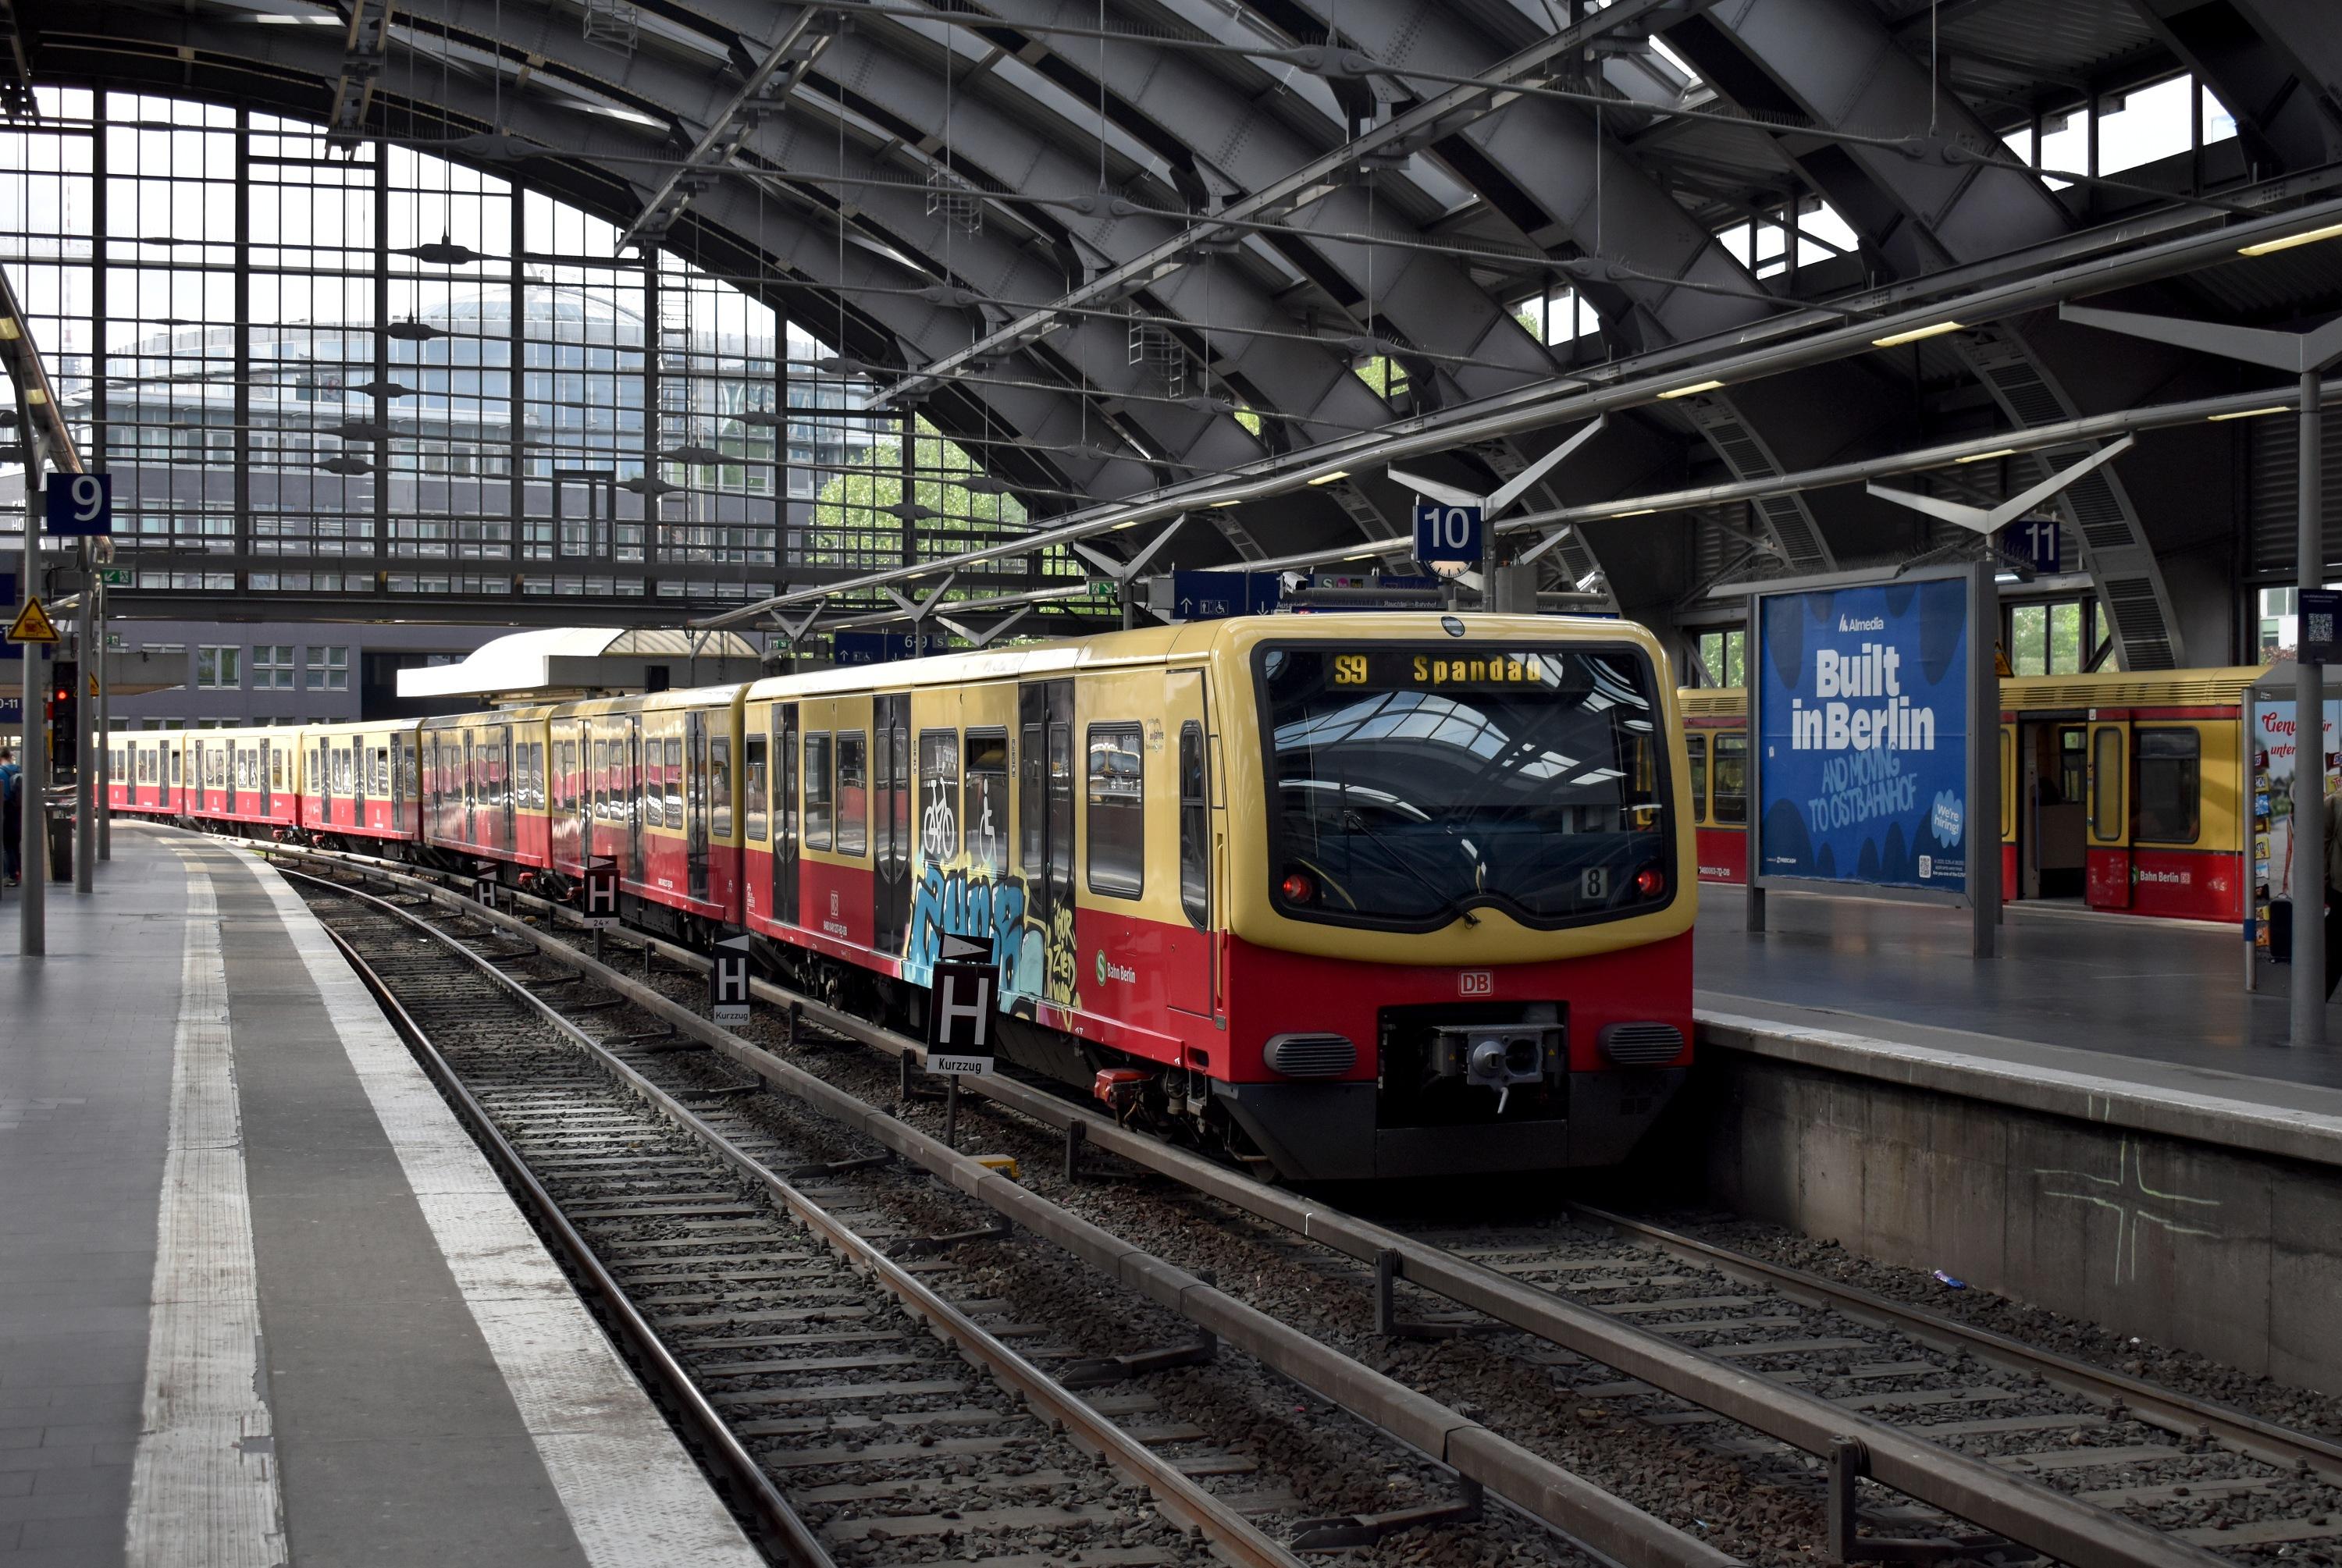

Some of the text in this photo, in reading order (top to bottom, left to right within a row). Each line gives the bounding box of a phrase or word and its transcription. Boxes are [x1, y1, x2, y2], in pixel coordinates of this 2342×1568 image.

[72, 475, 102, 521] 9
[1424, 508, 1469, 548] 10
[2025, 523, 2054, 561] 11
[1849, 617, 1884, 631] Almedia
[1335, 655, 1541, 684] S9 Spandau
[1817, 642, 1900, 698] Built
[1792, 695, 1934, 751] in Berlin
[2270, 743, 2296, 758] unter
[1821, 742, 1900, 794] AND MOVING
[1808, 773, 1917, 833] TO OSTBAHNHOF
[1937, 804, 1959, 822] We're
[1934, 814, 1959, 835] hiring!
[1588, 869, 1600, 897] 8
[2140, 870, 2157, 881] Bahn
[2159, 872, 2179, 883] Berlin
[479, 883, 496, 907] H
[589, 876, 615, 912] H
[718, 958, 746, 1001] H
[1107, 962, 1120, 980] Bahn
[1120, 965, 1136, 983] Berlin
[716, 1012, 748, 1022] Kurzzug
[939, 976, 989, 1045] H
[938, 1058, 982, 1074] Kurzzug
